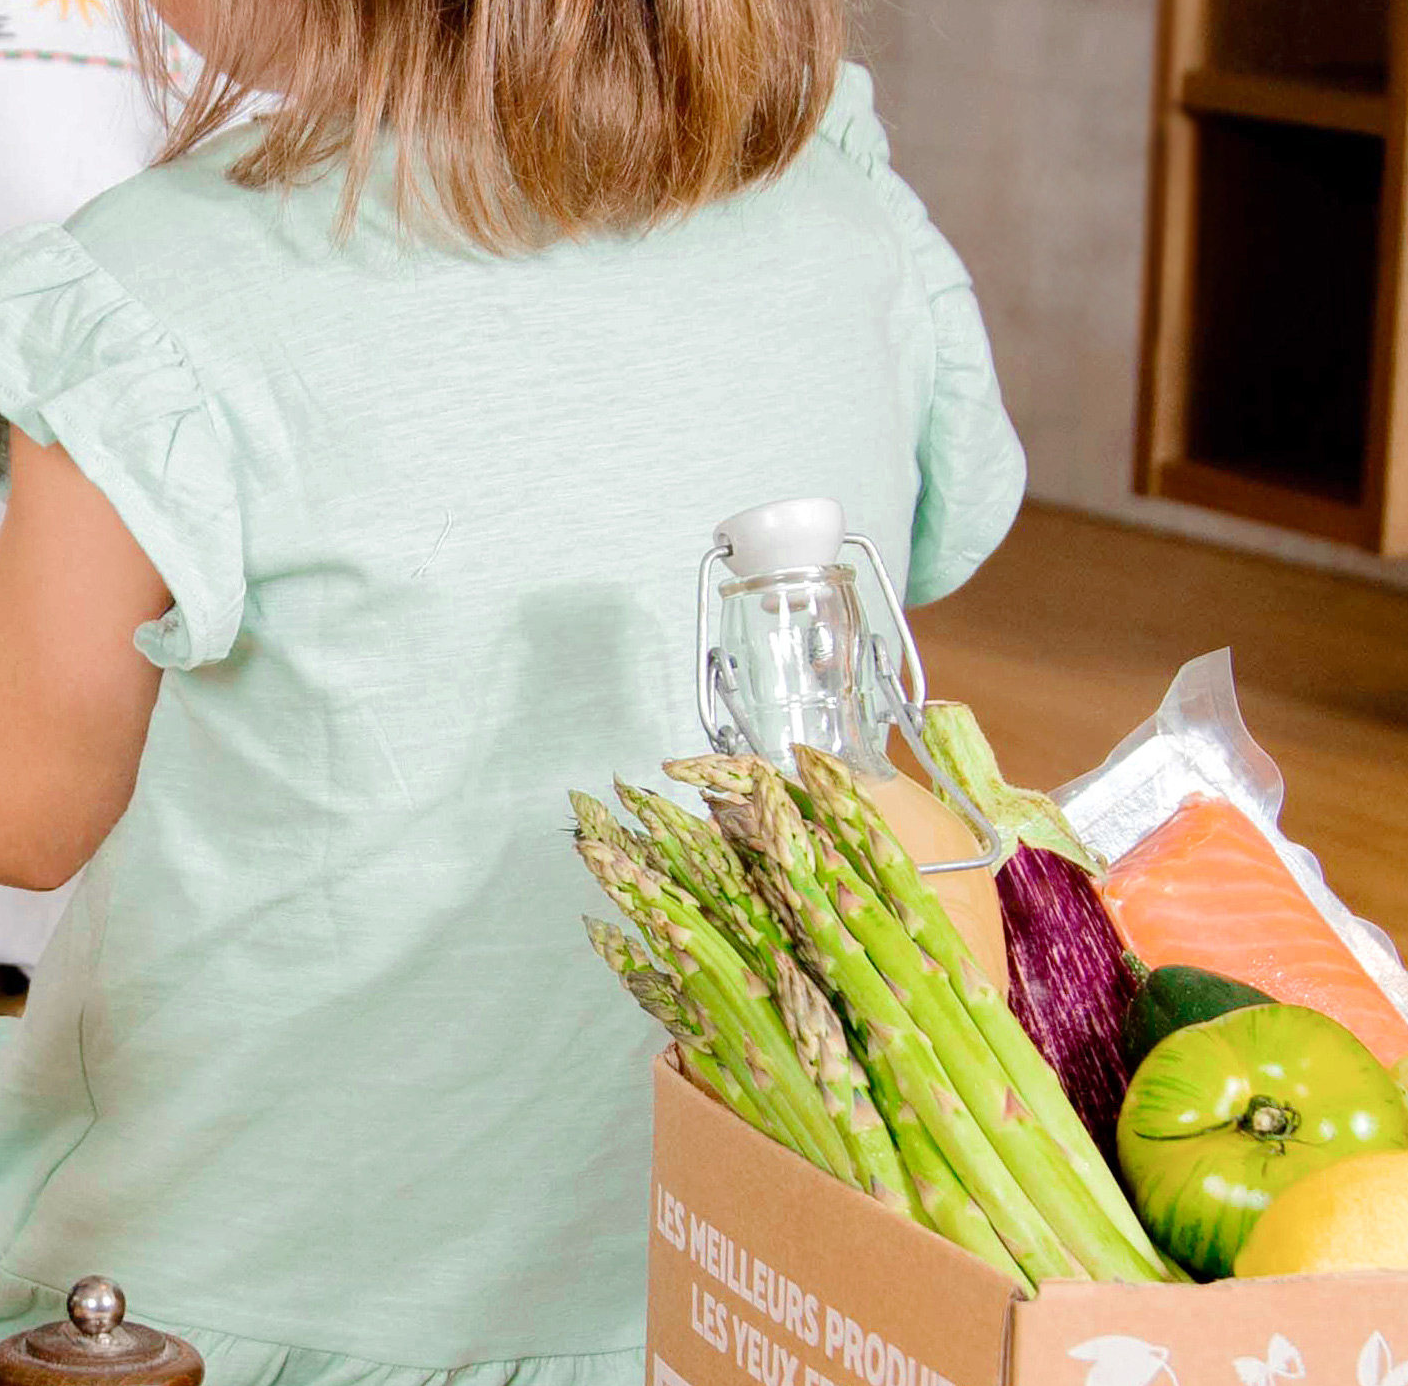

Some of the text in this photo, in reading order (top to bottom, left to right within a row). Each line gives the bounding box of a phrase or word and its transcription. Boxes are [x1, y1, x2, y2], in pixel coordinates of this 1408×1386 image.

[656, 1182, 687, 1252] LES
[690, 1211, 820, 1348] MEILLEURS
[692, 1281, 729, 1354] LES
